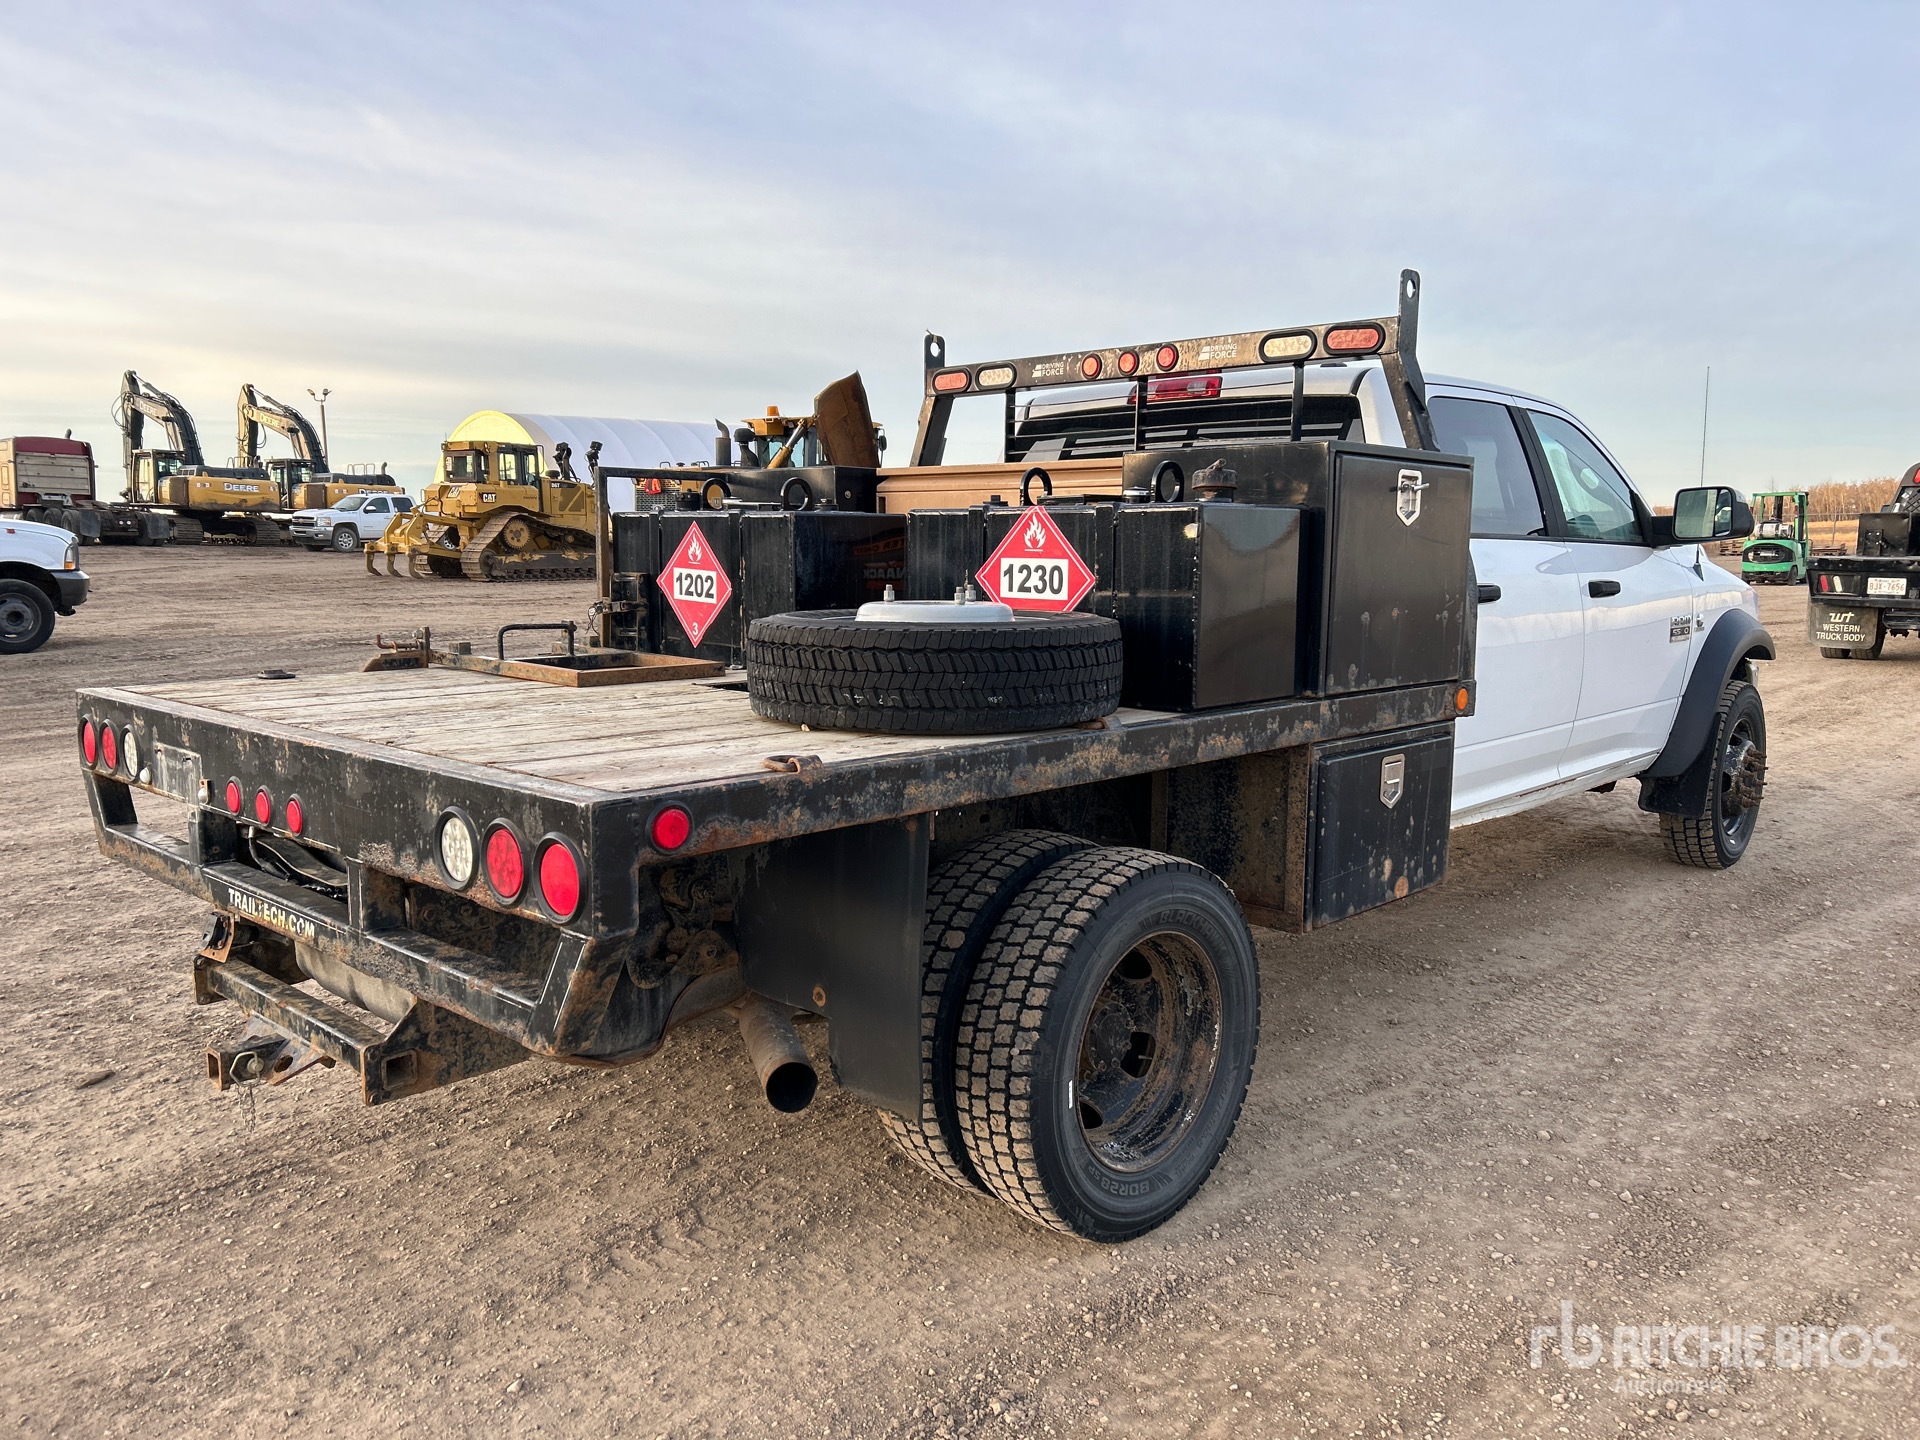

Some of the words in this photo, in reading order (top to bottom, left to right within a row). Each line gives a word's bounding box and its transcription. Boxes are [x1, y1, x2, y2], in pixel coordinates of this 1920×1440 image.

[1211, 343, 1237, 351] DRIVING
[1210, 349, 1237, 358] FORCE
[1041, 361, 1064, 369] DRIVING
[1041, 367, 1064, 377] FORCE
[139, 402, 158, 416] DEERE
[260, 414, 281, 428] DEERE
[223, 482, 259, 493] DEERE
[482, 493, 496, 503] CAT
[1003, 563, 1064, 595] 1230
[675, 572, 715, 599] 1202
[692, 622, 699, 636] 3
[1822, 623, 1861, 633] WESTERN
[1816, 631, 1842, 641] TRUCK
[1843, 633, 1866, 642] BODY
[227, 888, 315, 938] TRAILTECH.COM
